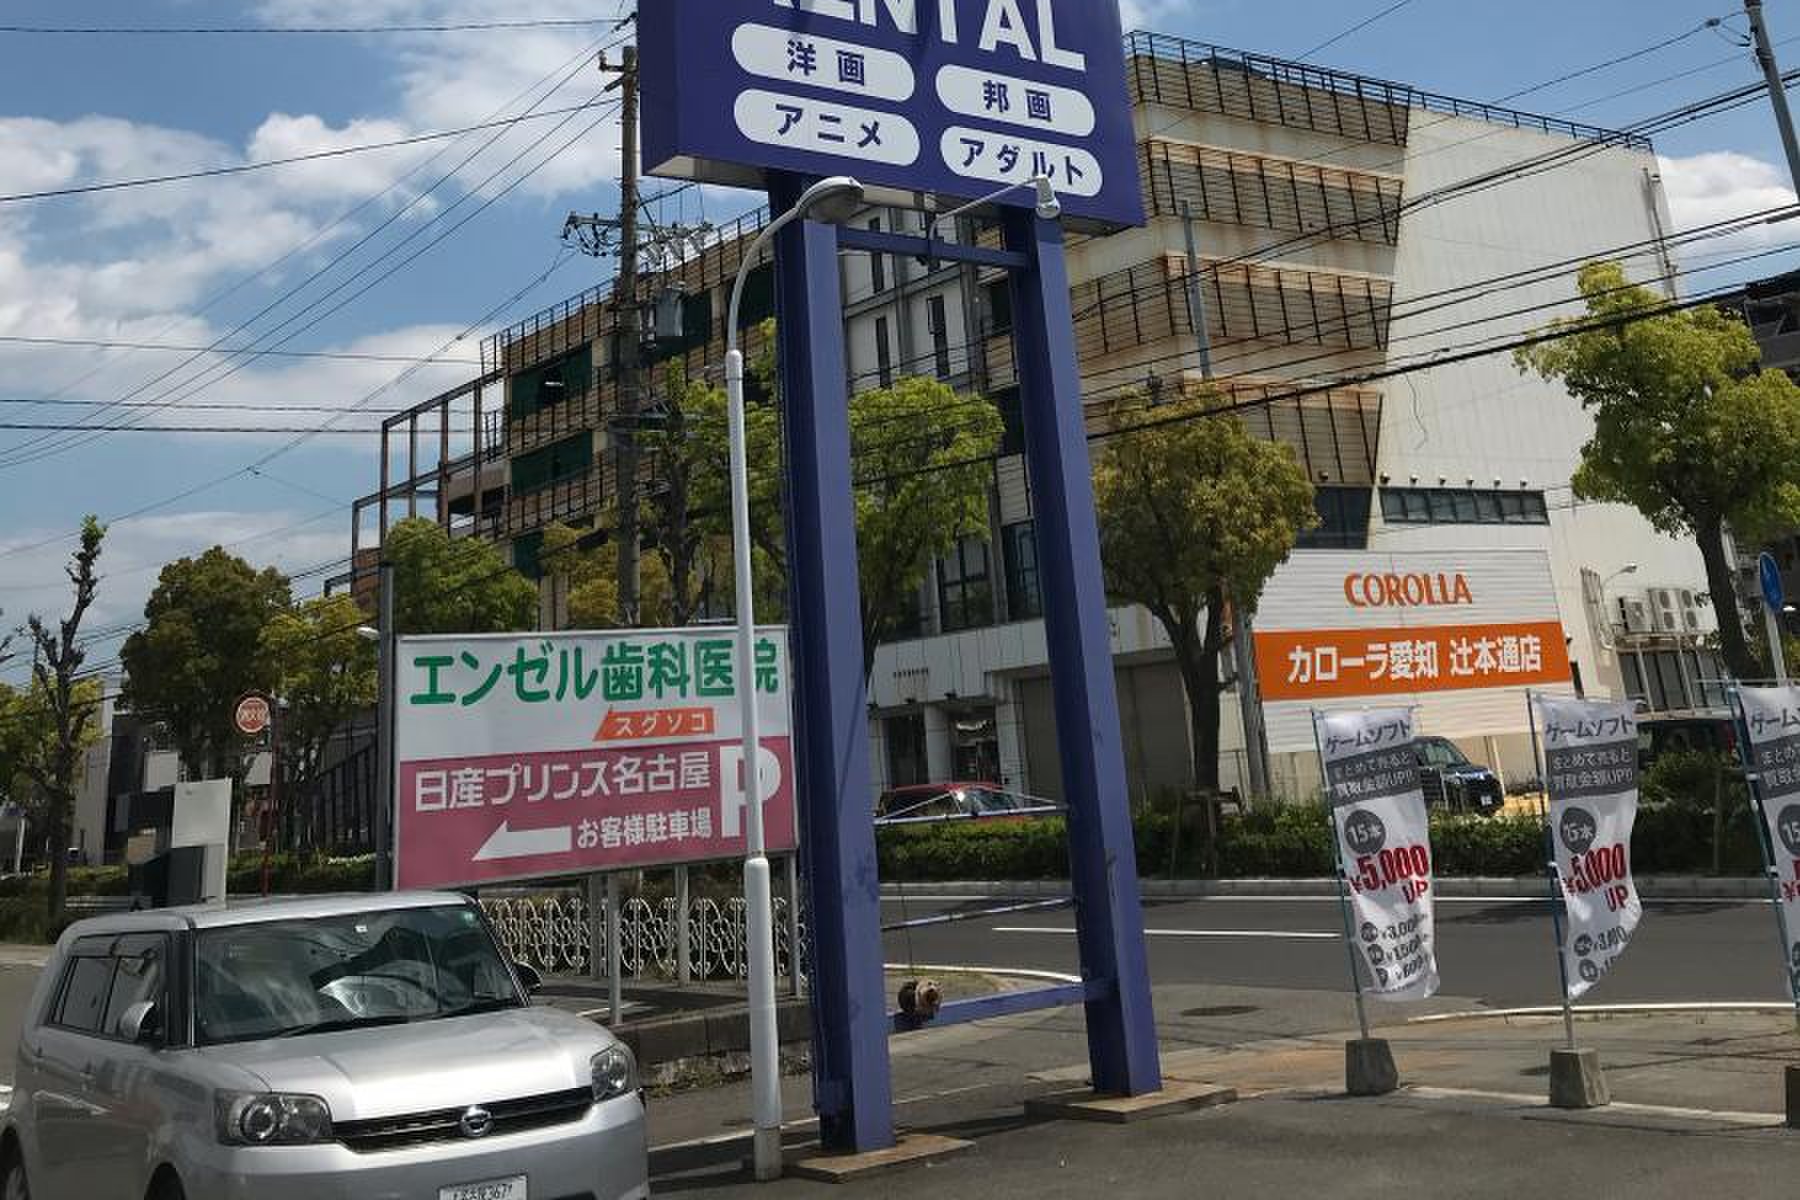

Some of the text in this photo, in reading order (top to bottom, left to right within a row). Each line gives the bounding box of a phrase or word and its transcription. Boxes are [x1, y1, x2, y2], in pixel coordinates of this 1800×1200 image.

[786, 40, 866, 86] 洋画
[982, 79, 1052, 123] 邦画
[774, 102, 883, 148] アニメ
[959, 136, 1084, 186] アダルト
[1343, 572, 1473, 607] COROLLA
[1287, 639, 1439, 684] カローラ愛知
[615, 711, 708, 736] スグソコ
[1326, 720, 1410, 753] ゲームソフト
[1545, 715, 1633, 742] ゲームソフト
[1751, 706, 1800, 735] ゲーム
[414, 751, 711, 812] 日産プリンス名古屋
[719, 744, 782, 839] P
[577, 807, 712, 850] お客様駐車場
[1402, 880, 1429, 905] UP
[1604, 884, 1629, 913] UP
